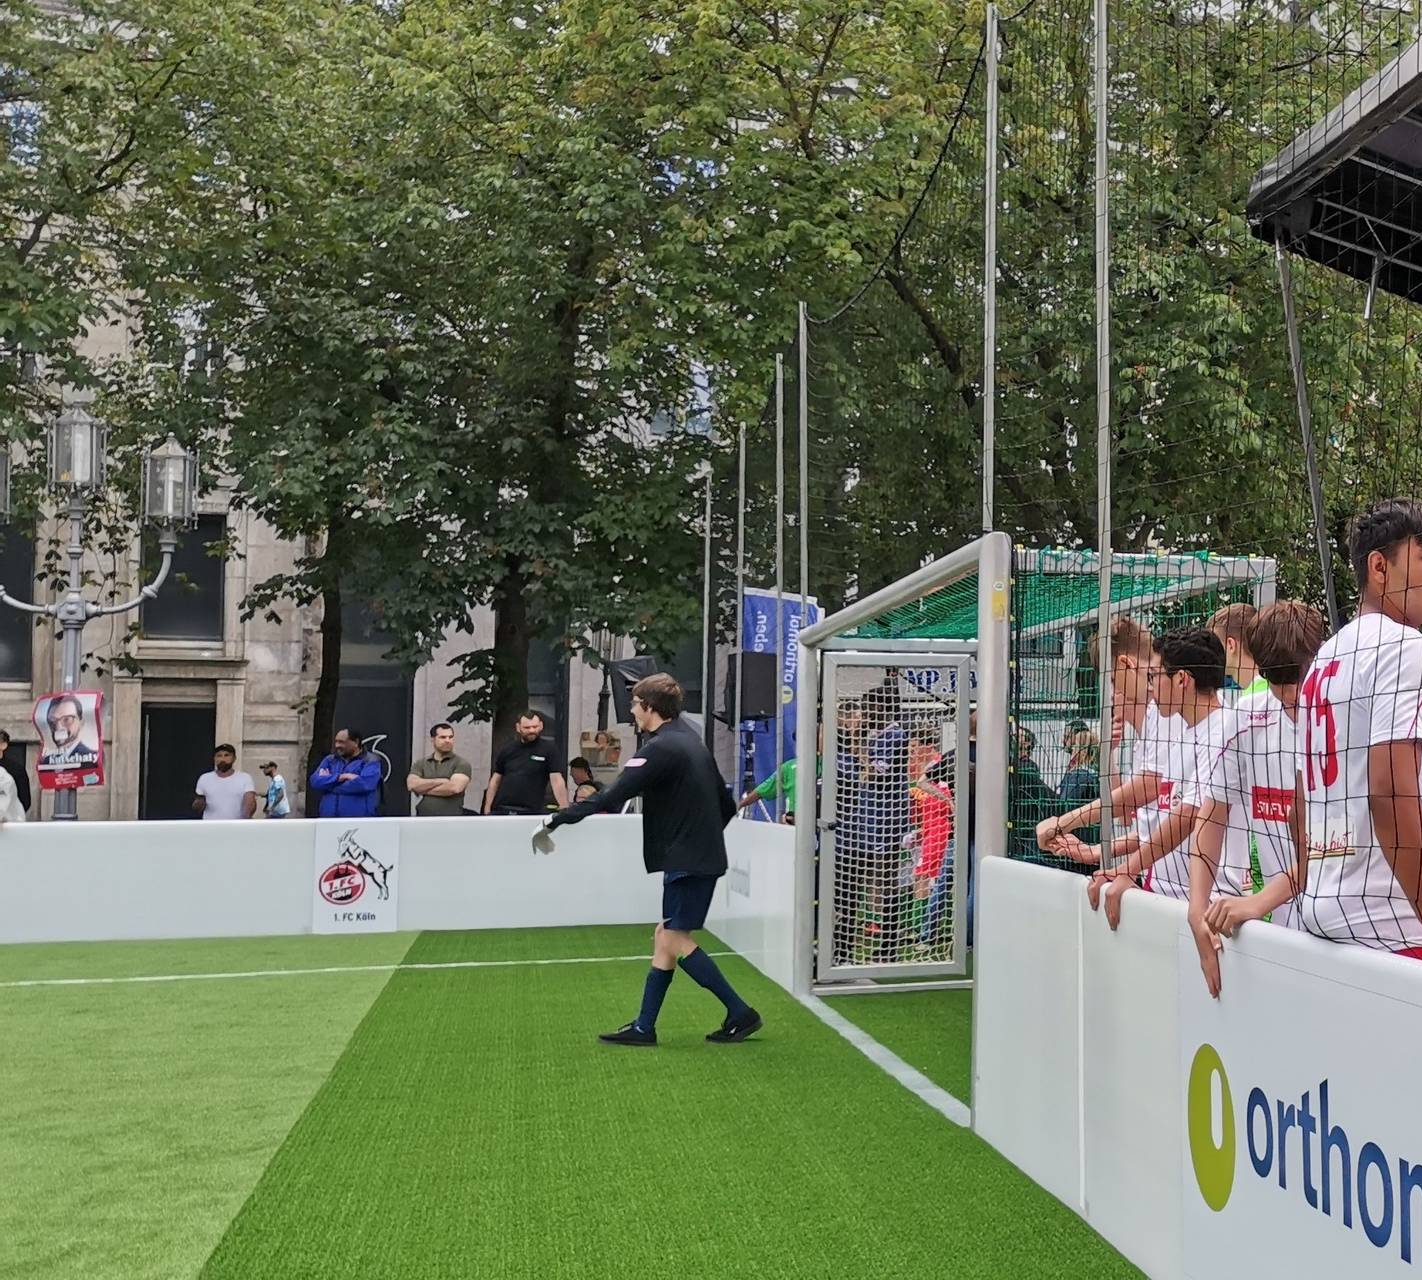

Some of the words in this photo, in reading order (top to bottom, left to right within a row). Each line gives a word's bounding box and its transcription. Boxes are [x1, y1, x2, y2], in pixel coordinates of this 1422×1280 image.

[1302, 660, 1340, 792] 15
[342, 911, 354, 921] FC
[355, 910, 376, 921] Köln
